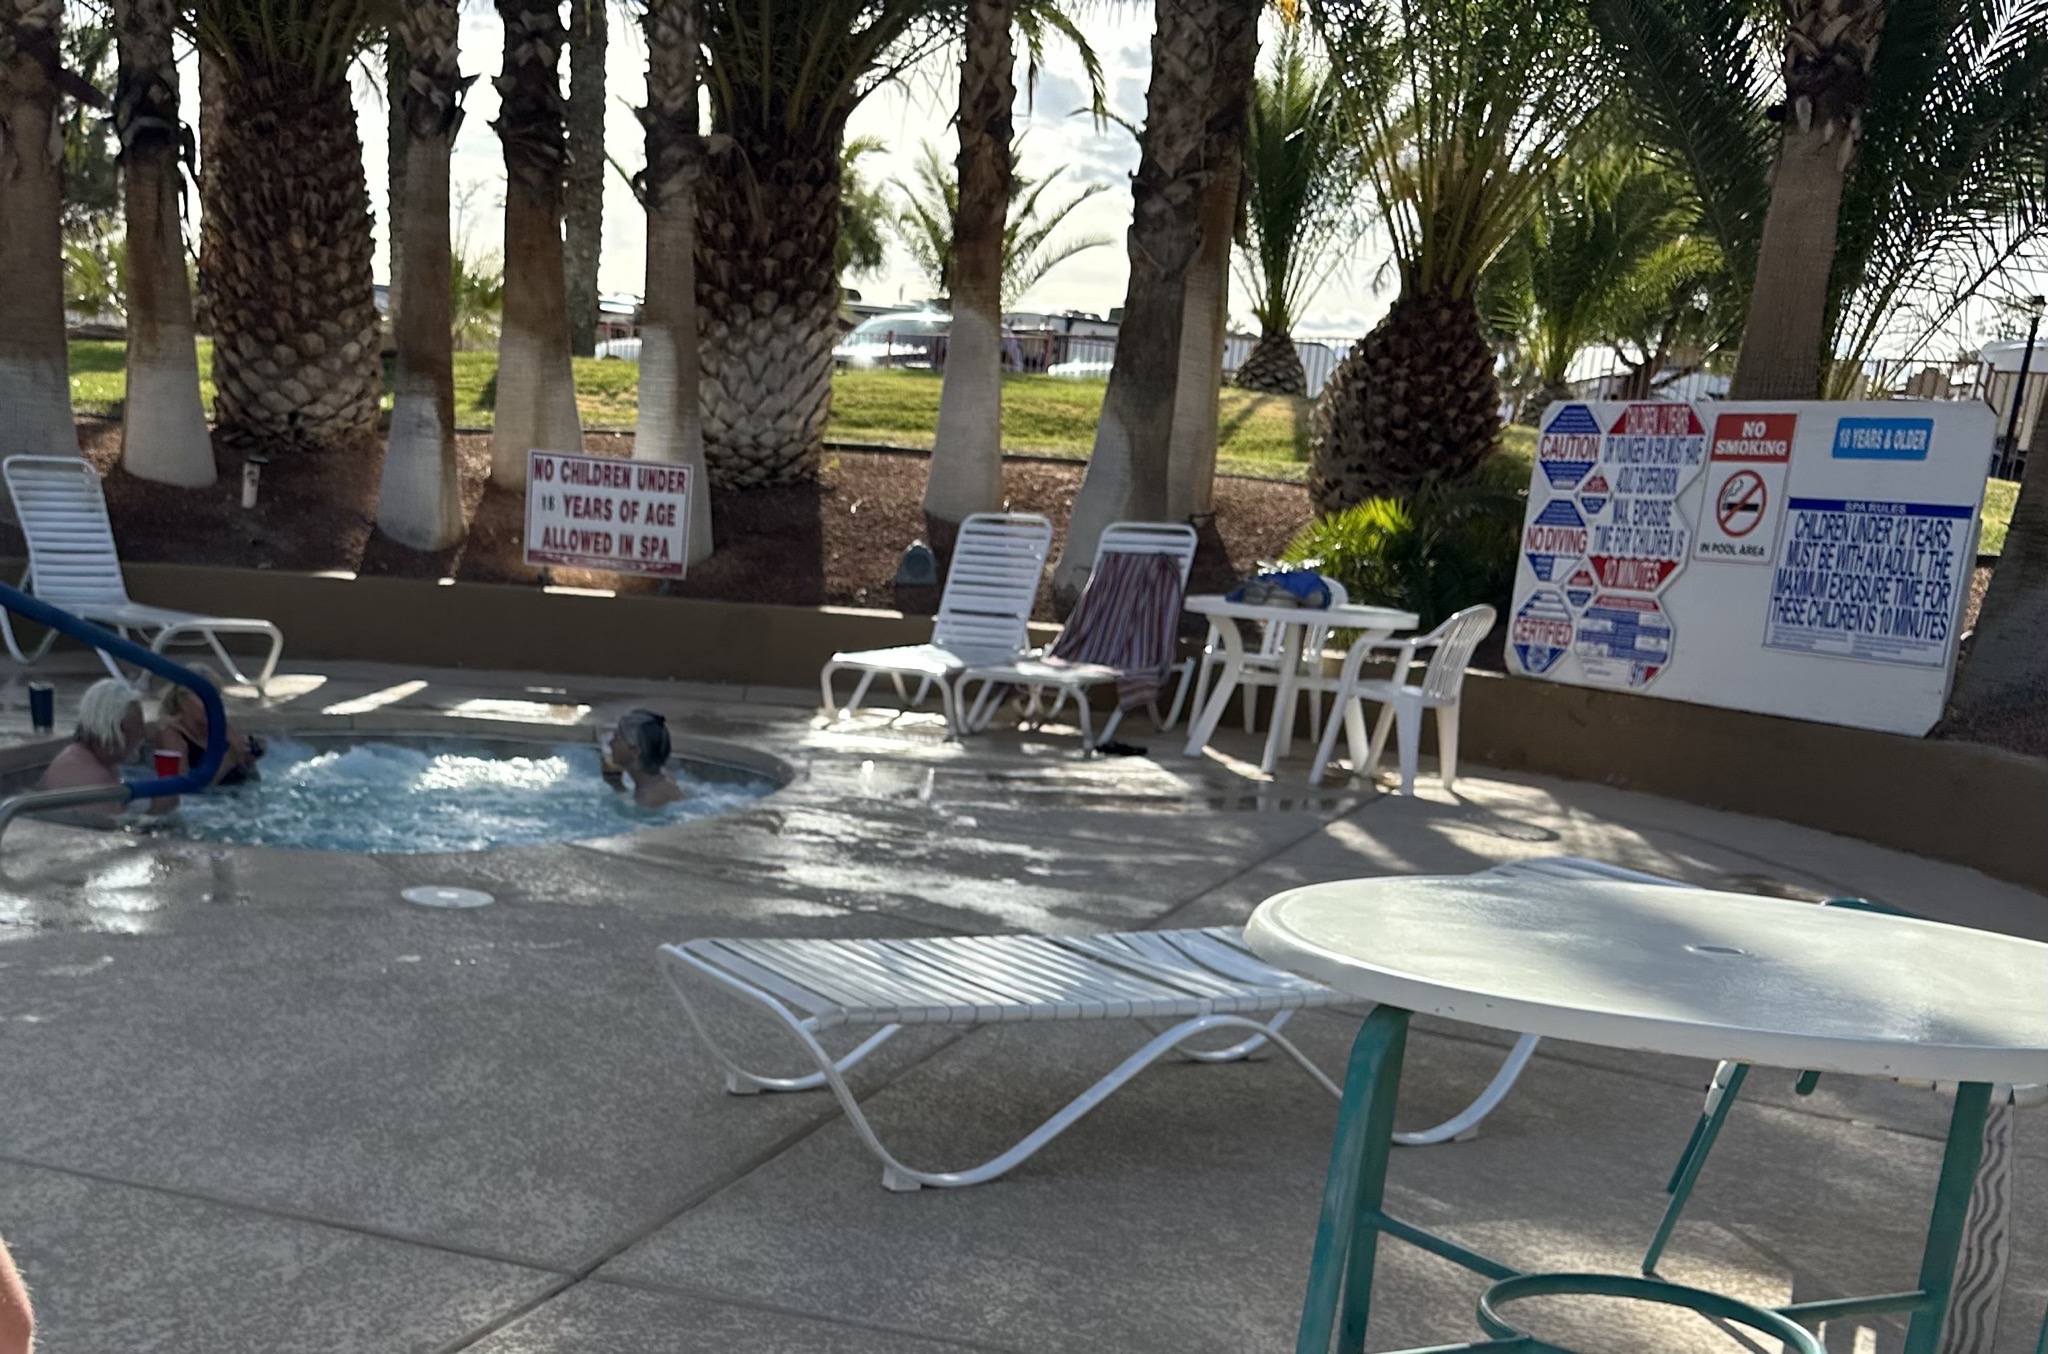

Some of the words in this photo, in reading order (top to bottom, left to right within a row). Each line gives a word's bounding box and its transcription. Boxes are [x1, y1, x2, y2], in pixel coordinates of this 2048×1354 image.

[1742, 421, 1767, 438] NO
[1540, 436, 1600, 461] CAUTION
[1715, 439, 1788, 457] SMOKING
[535, 458, 554, 481] NO
[560, 461, 631, 490] CHILDREN
[637, 468, 686, 494] UNDER
[563, 495, 612, 522] YEARS
[620, 500, 639, 524] OF
[644, 503, 676, 527] AGE
[542, 527, 612, 554] ALLOWED
[619, 534, 634, 557] IN
[640, 536, 670, 560] SPA
[1526, 528, 1545, 551] NO
[1544, 529, 1589, 554] DIVING
[1795, 511, 1848, 541] CHILDREN
[1849, 516, 1894, 544] UNDER
[1894, 518, 1909, 546] 12
[1910, 518, 1953, 549] YEARS
[1818, 542, 1837, 570] BE
[1927, 550, 1954, 580] THE
[1828, 573, 1893, 604] EXPOSURE
[1922, 580, 1951, 610] FOR
[1772, 597, 1808, 626] THESE
[1807, 600, 1866, 632] CHILDREN
[1864, 605, 1878, 633] IS
[1878, 606, 1893, 635] 10
[1513, 619, 1573, 646] CERTIFIED
